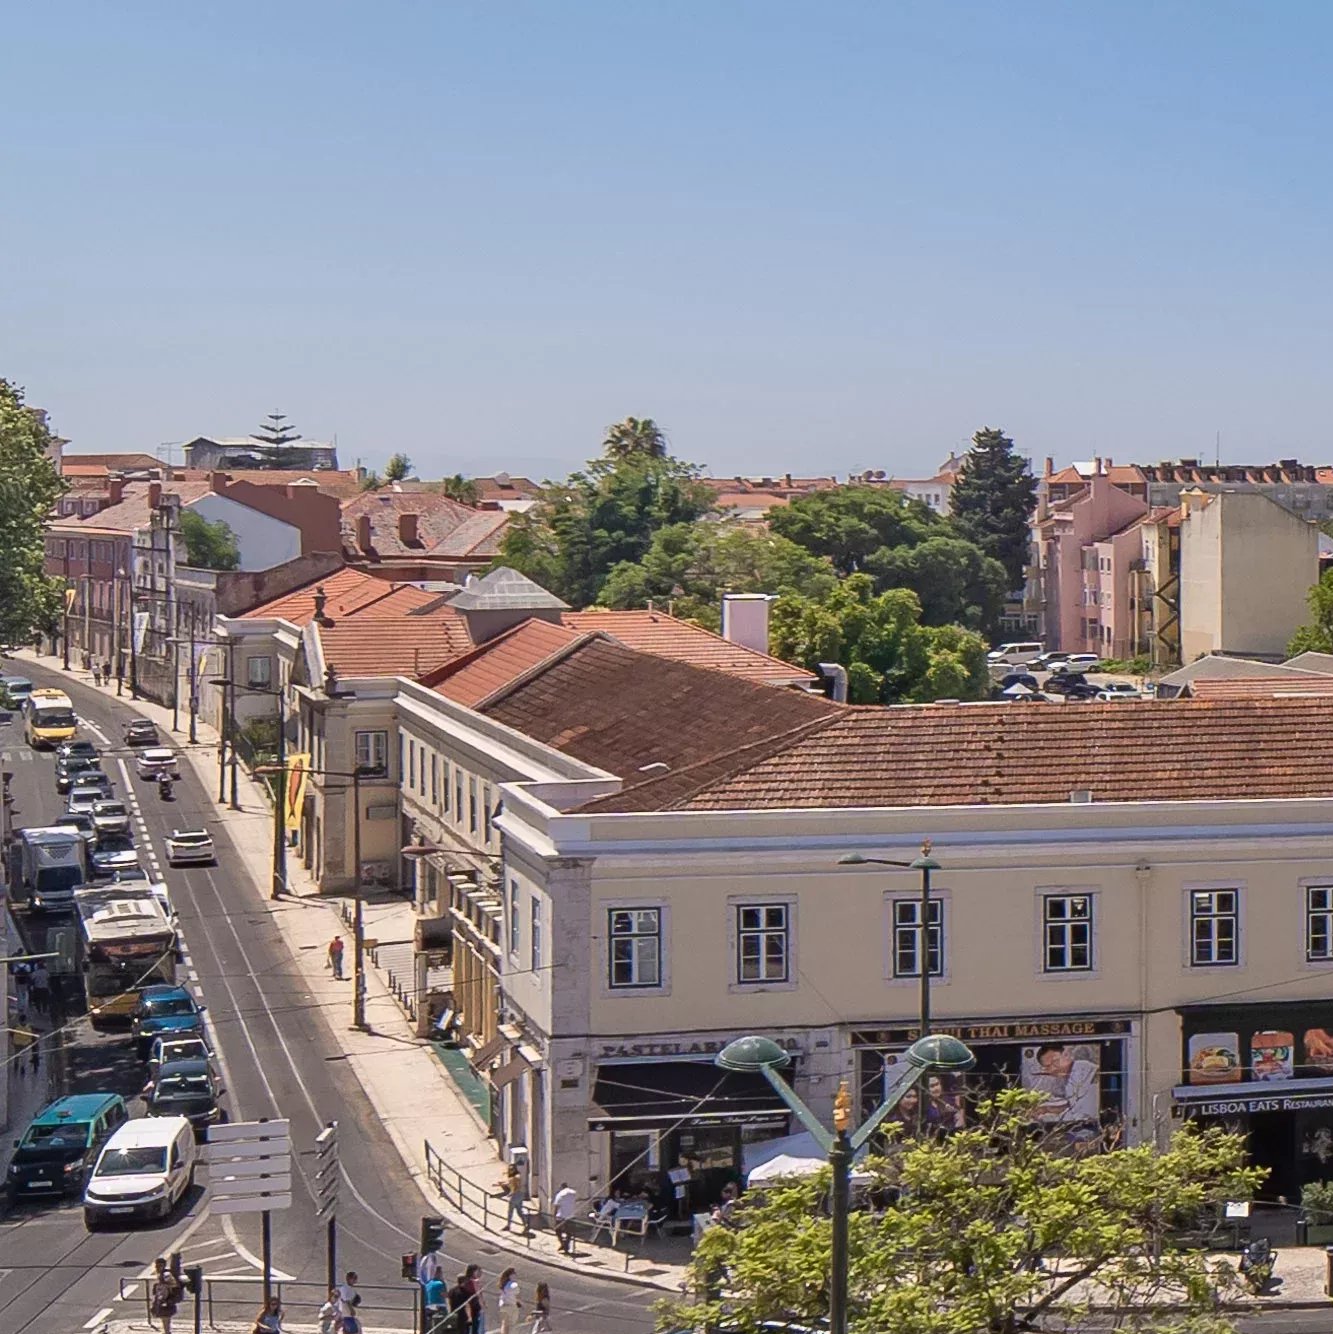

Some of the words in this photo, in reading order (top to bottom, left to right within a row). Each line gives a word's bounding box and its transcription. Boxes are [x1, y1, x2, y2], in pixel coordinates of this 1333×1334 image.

[968, 1024, 1009, 1038] THAI
[1015, 1021, 1096, 1037] MASSAGE
[1201, 1102, 1247, 1116] LISBOA
[1249, 1099, 1279, 1112] EATS
